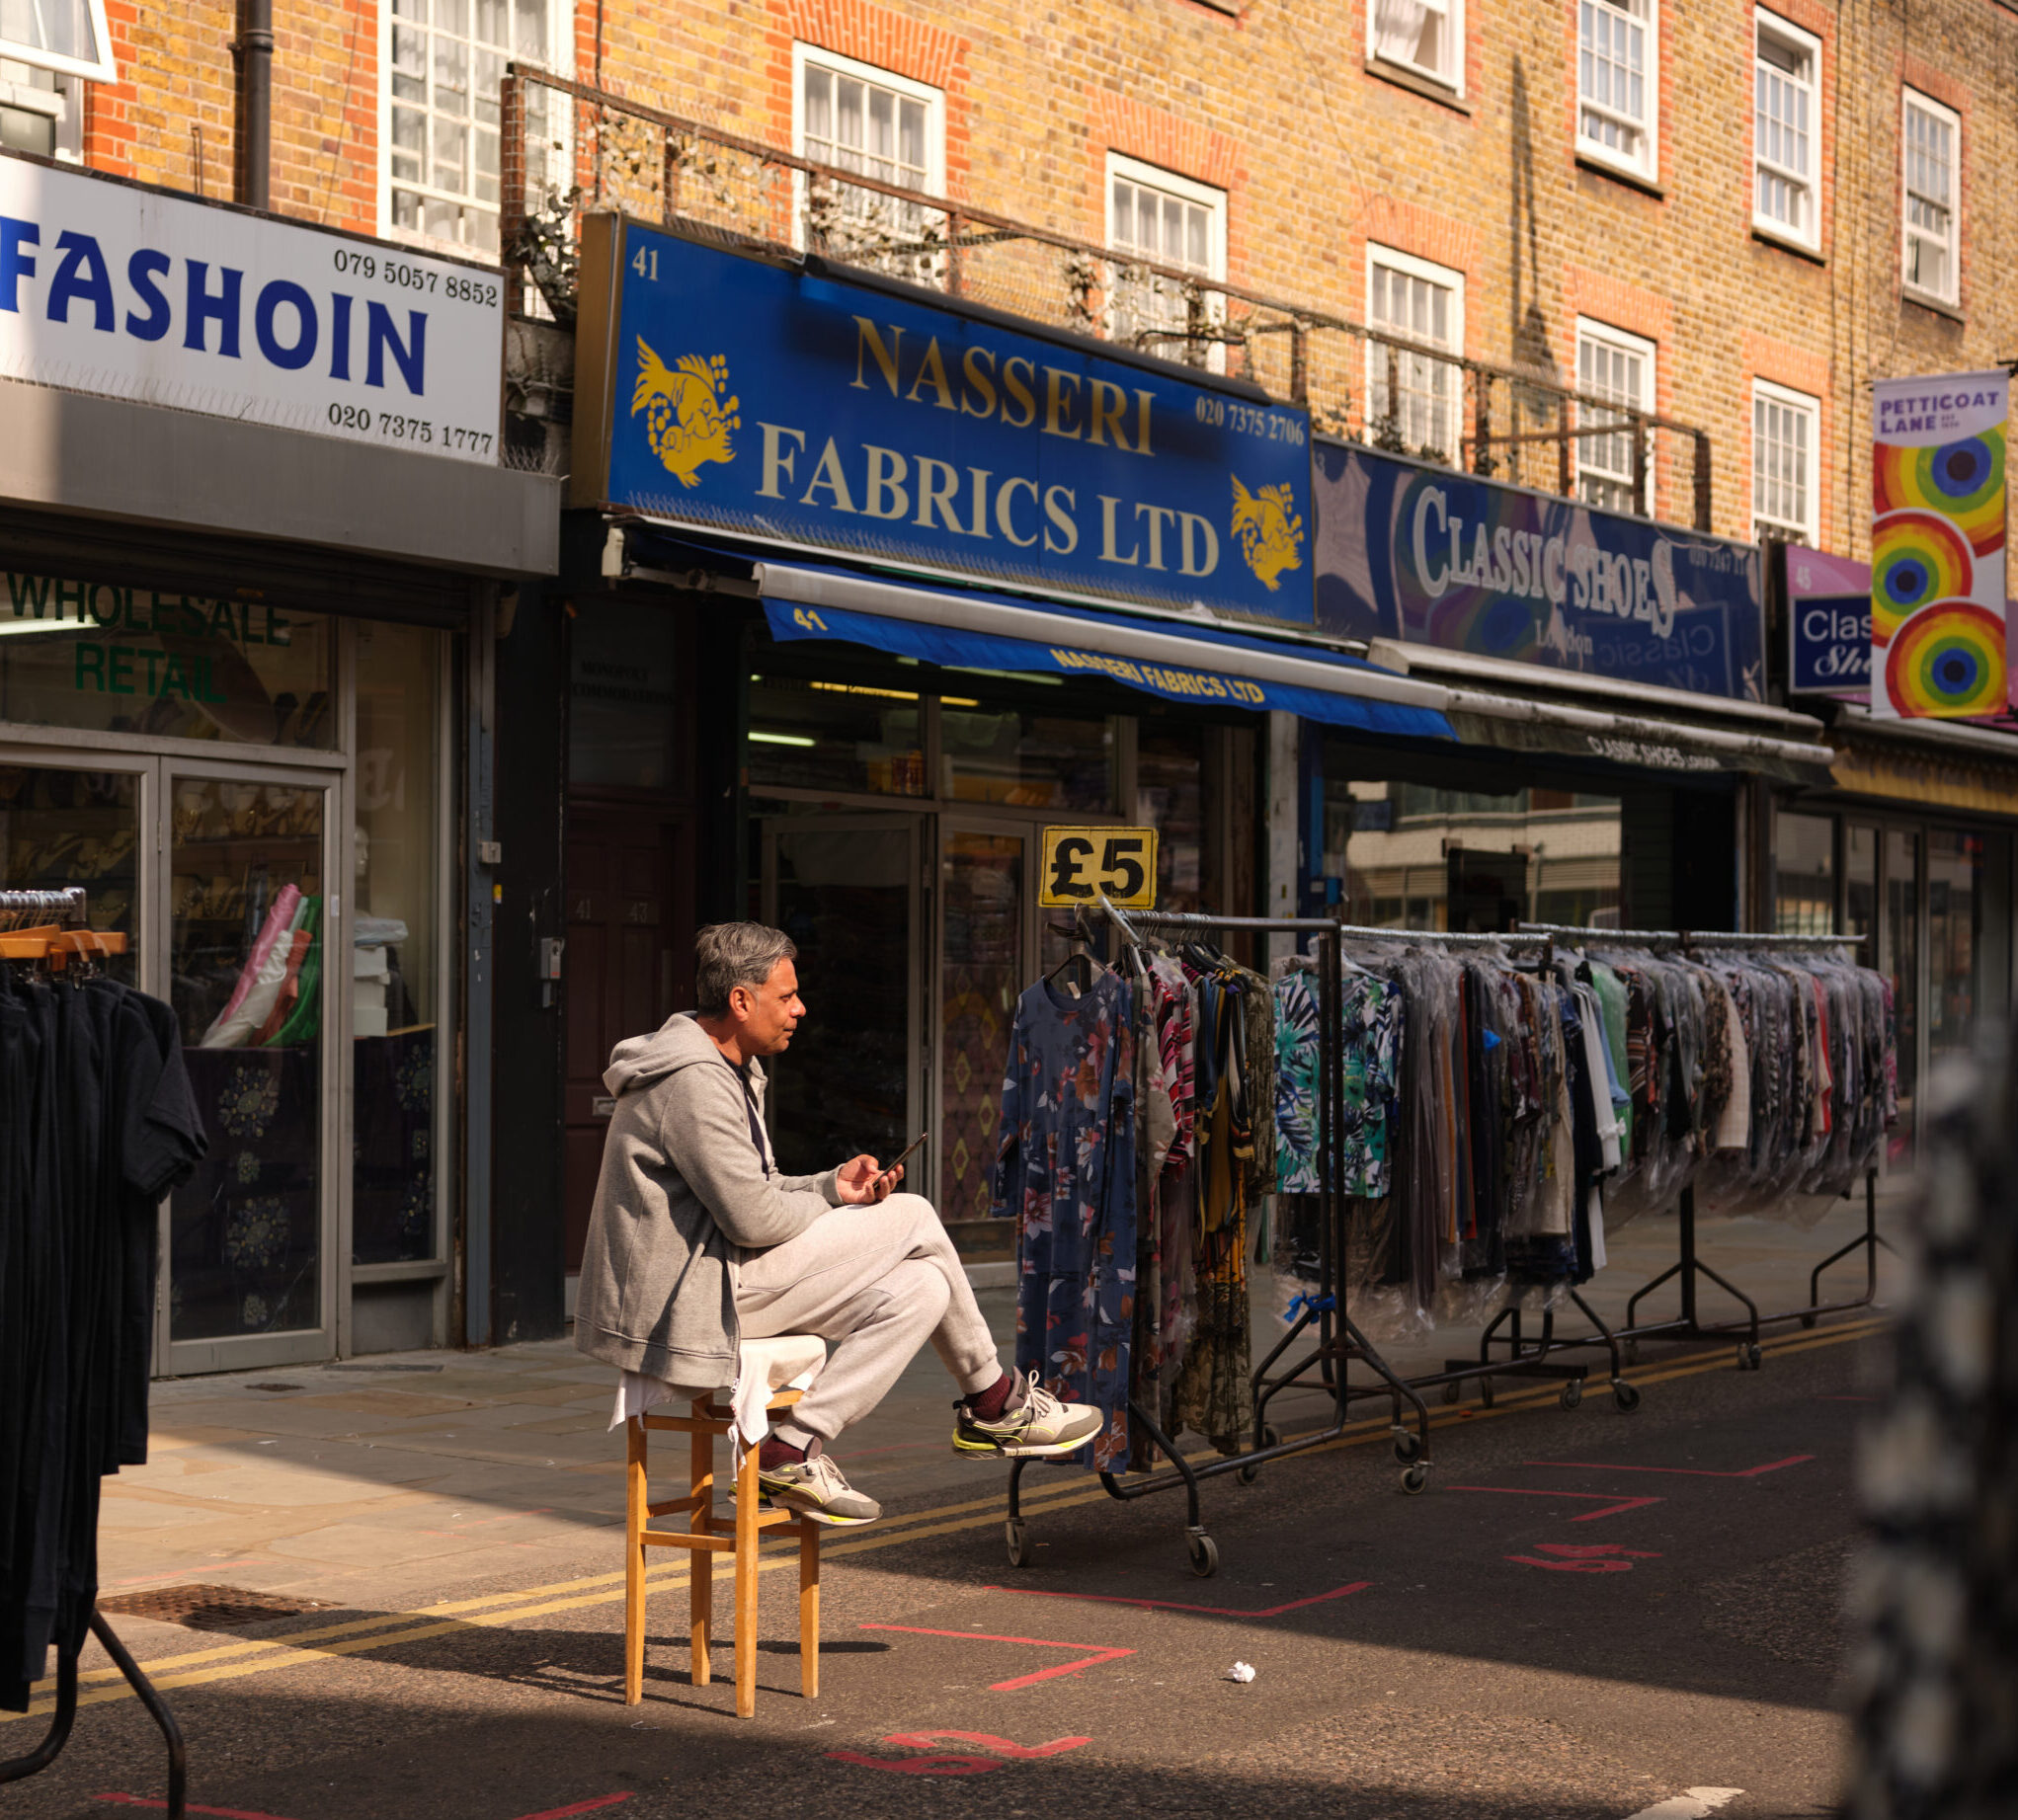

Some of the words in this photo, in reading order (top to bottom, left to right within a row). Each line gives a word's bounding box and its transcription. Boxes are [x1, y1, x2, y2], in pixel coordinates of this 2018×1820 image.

[334, 249, 375, 278] 079
[384, 262, 438, 293] 5057
[445, 277, 497, 307] 8852
[632, 245, 658, 281] 41
[0, 216, 429, 396] FASHOIN
[849, 315, 1157, 456] NASSERI
[1880, 392, 1999, 416] PETTICOAT
[329, 403, 370, 431] 020
[379, 413, 432, 442] 7375
[443, 426, 492, 454] 1777
[1196, 396, 1225, 427] 020
[1229, 404, 1265, 436] 7375
[1268, 414, 1305, 446] 2706
[1880, 415, 1936, 435] LANE
[755, 421, 1079, 555] FABRICS
[1097, 494, 1220, 577] LTD
[1413, 486, 1565, 603] CLASSIC
[1574, 538, 1674, 640] SHOES
[7, 572, 291, 648] WHOLESALE
[794, 608, 828, 631] 41
[75, 642, 227, 704] RETAIL
[1049, 648, 1144, 684] NASSERI
[1140, 665, 1228, 697] FABRICS
[1224, 678, 1265, 704] LTD
[1050, 837, 1145, 899] £5
